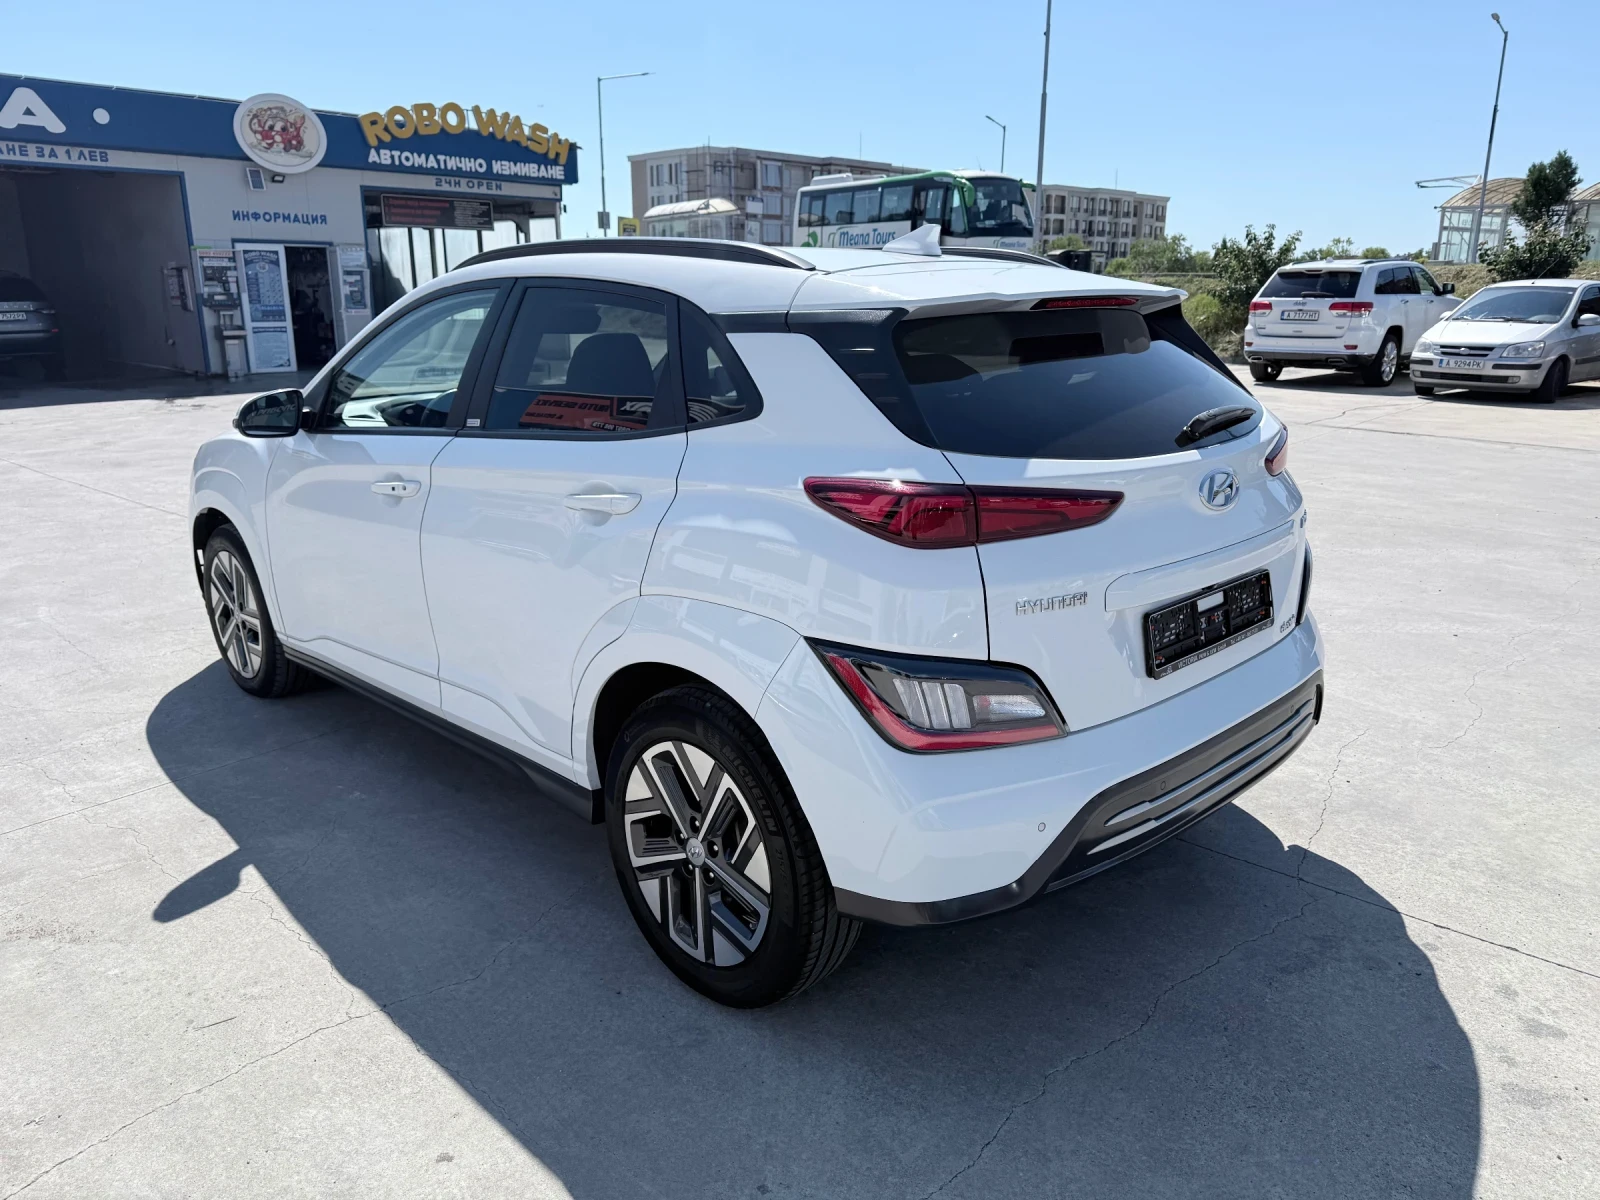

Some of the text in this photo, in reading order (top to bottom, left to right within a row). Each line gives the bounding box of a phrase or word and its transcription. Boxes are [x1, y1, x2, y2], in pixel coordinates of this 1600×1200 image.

[359, 102, 570, 164] ROBO WASH
[35, 145, 58, 159] ЗА
[65, 148, 72, 160] 1
[77, 149, 109, 163] ЛЕВ
[368, 148, 565, 180] АВТОМАТИЧНО ИЗМИВАНЕ
[466, 180, 503, 191] OPEN
[232, 210, 328, 225] ИНФОРМАЦИЯ
[839, 228, 896, 247] Meana Tours
[1016, 591, 1087, 616] HYUNDAI
[721, 744, 778, 833] MICHELIN
